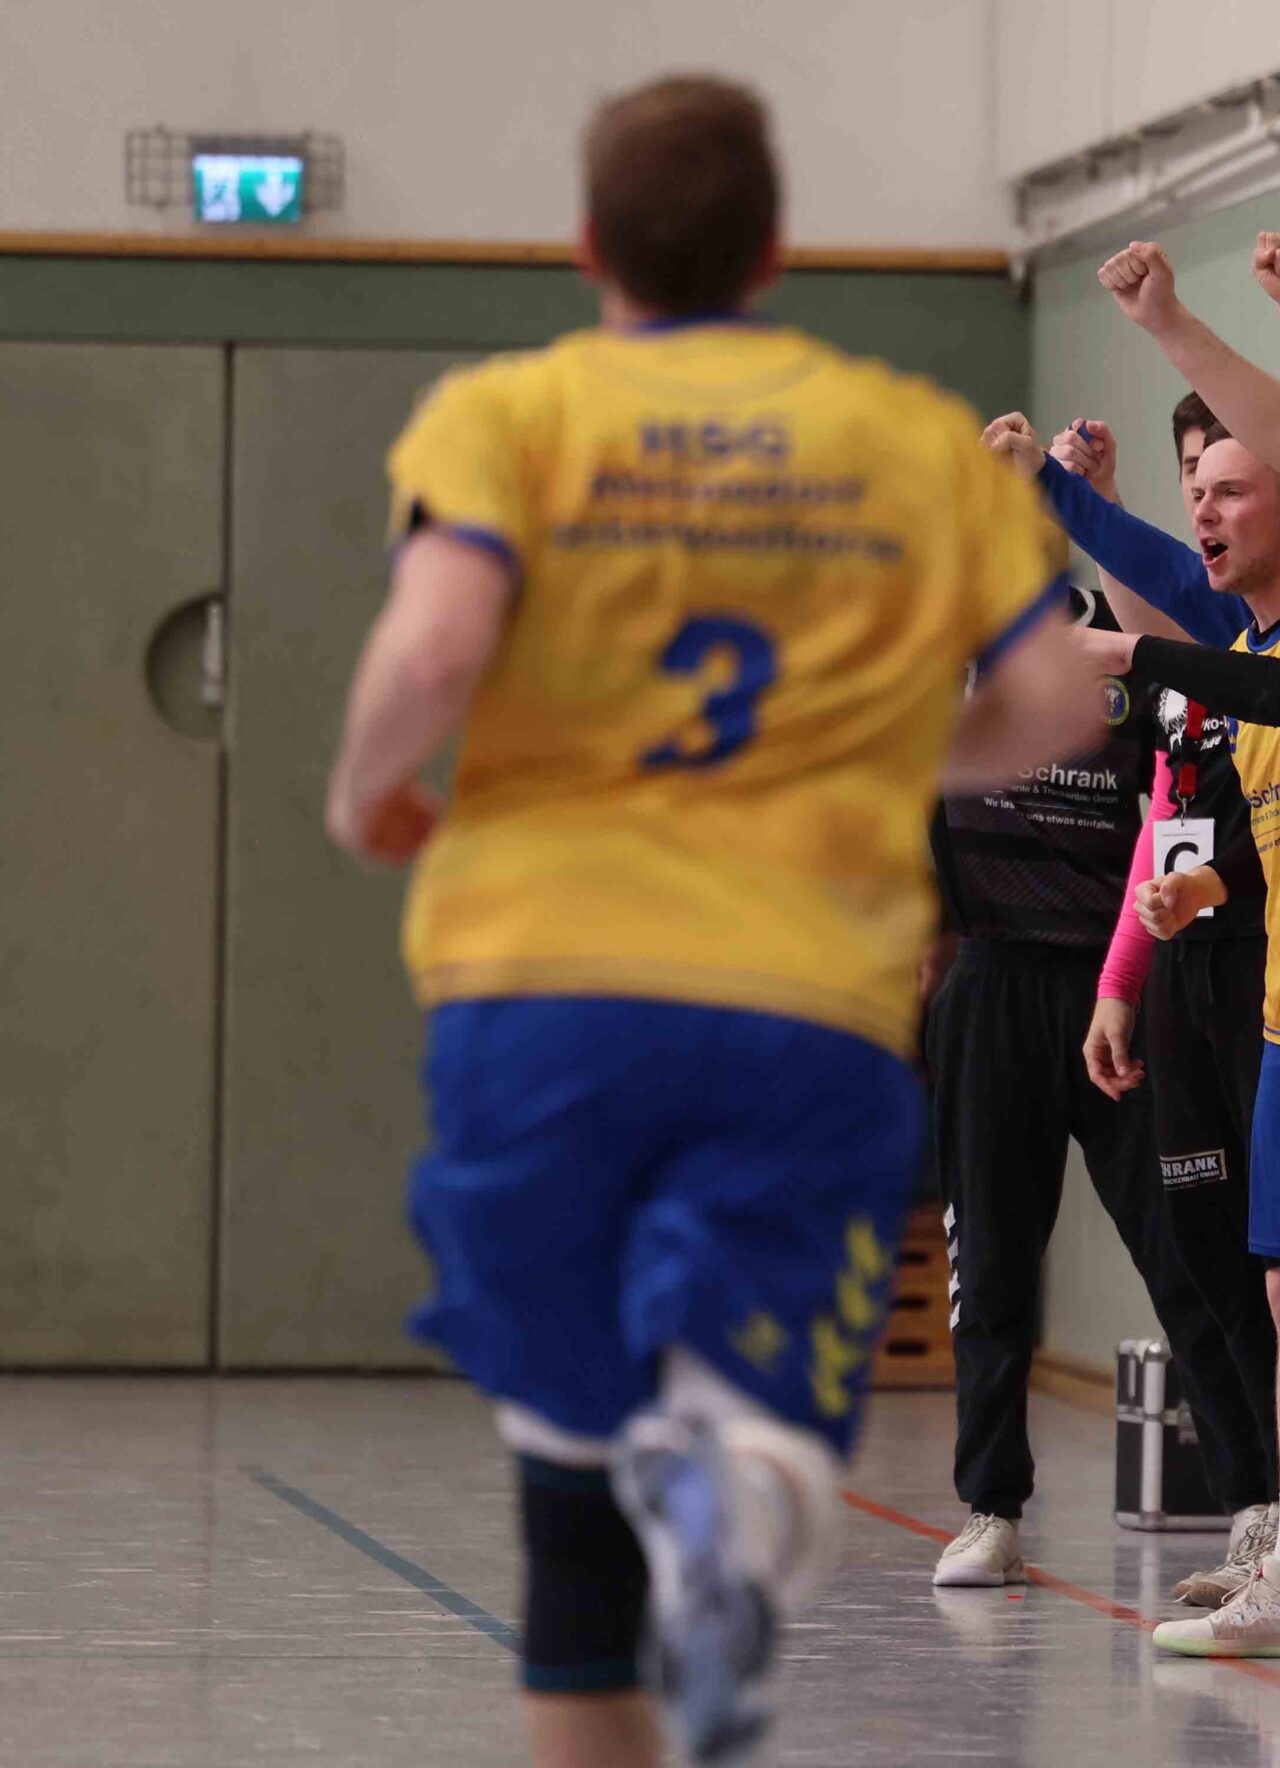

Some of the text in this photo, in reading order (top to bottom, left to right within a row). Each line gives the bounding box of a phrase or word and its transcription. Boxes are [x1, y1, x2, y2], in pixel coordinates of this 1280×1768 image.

[641, 423, 789, 460] HSG
[638, 612, 780, 770] 3
[1164, 841, 1199, 876] C
[1161, 1156, 1218, 1177] HRANK
